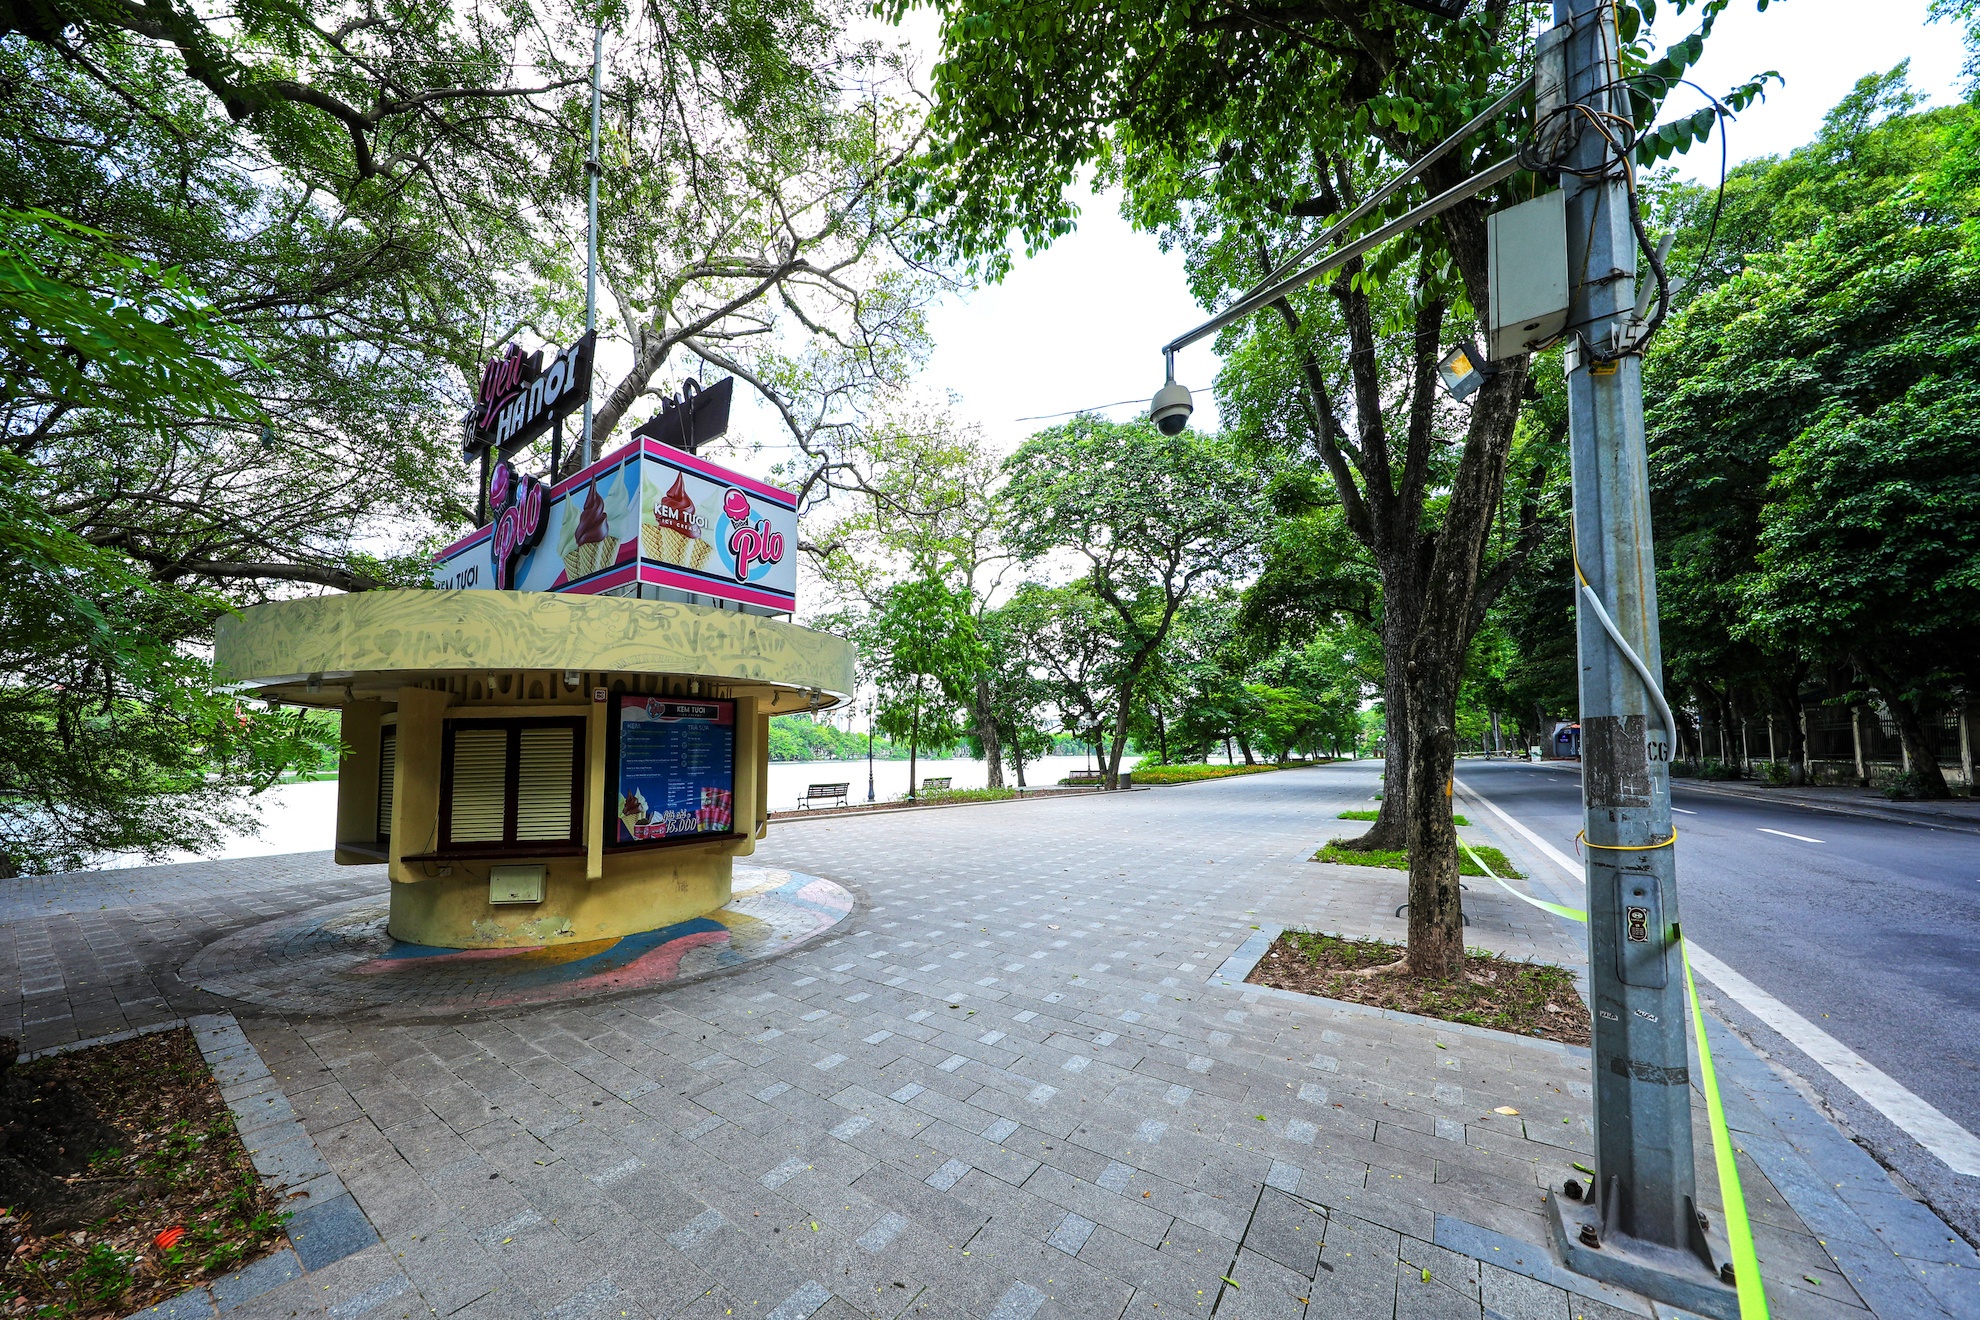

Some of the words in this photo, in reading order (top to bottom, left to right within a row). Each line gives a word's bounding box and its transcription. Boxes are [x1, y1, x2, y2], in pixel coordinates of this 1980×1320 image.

[654, 503, 679, 520] KEM
[662, 518, 673, 526] ICE
[677, 706, 690, 714] KEM
